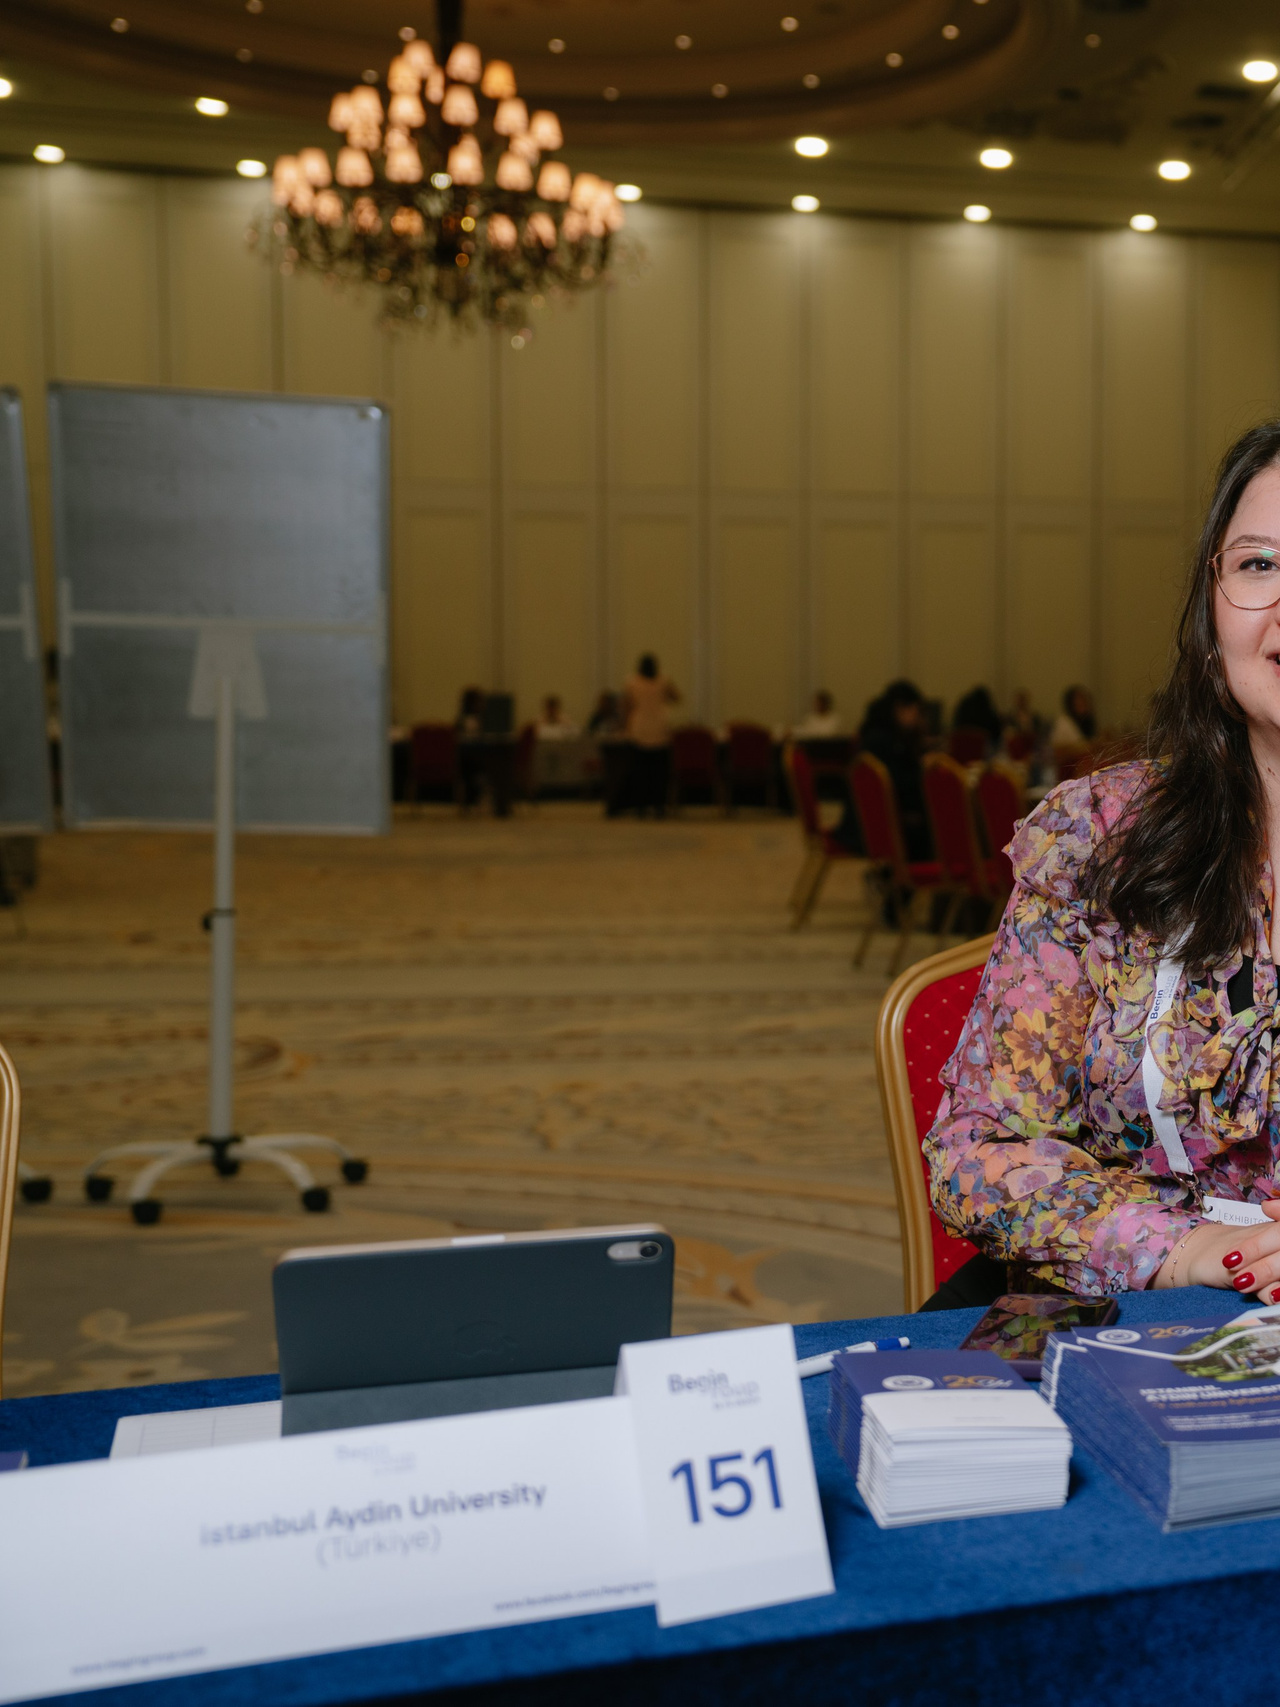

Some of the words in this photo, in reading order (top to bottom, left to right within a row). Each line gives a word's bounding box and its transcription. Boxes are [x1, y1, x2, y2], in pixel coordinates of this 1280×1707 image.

[1150, 989, 1164, 1019] Begin
[668, 1369, 729, 1395] Begin
[671, 1446, 783, 1523] 151
[325, 1500, 402, 1533] Aydin
[408, 1482, 548, 1520] University
